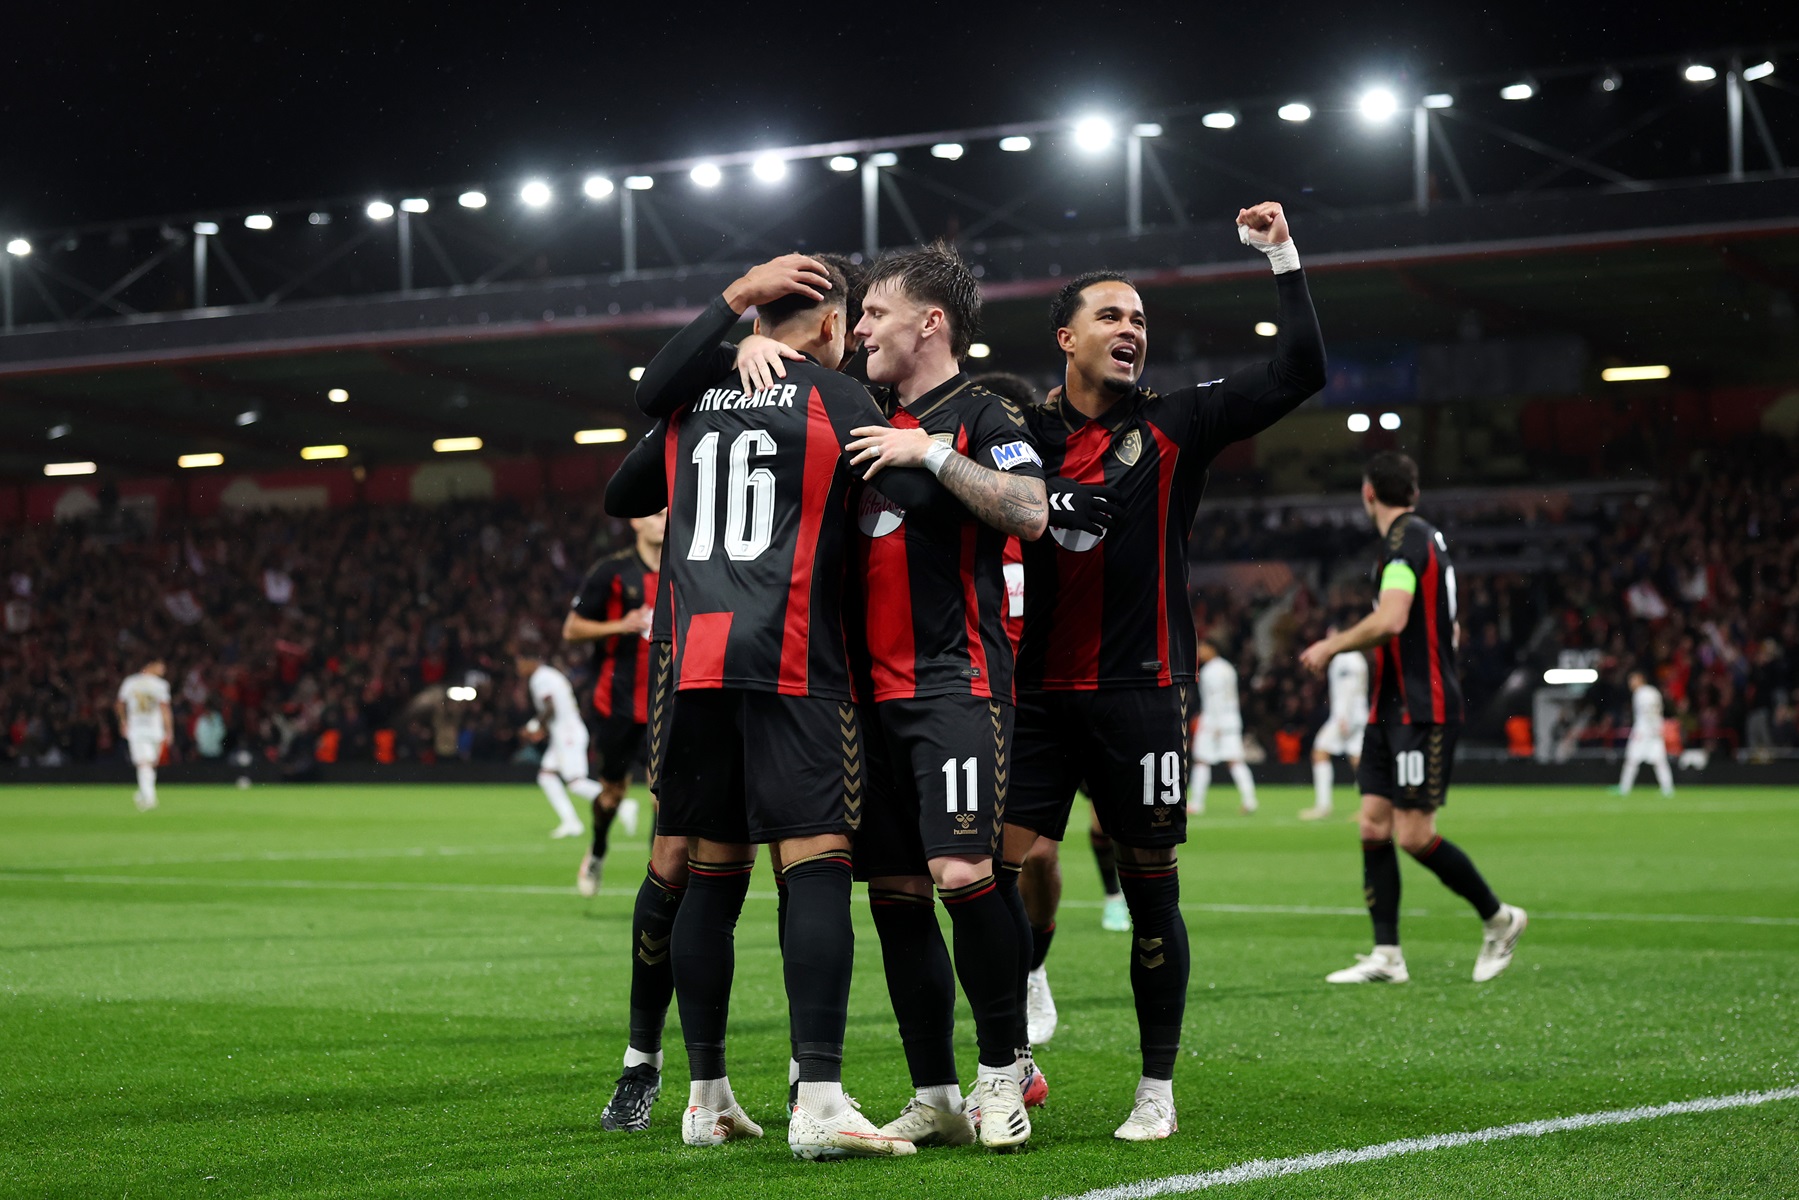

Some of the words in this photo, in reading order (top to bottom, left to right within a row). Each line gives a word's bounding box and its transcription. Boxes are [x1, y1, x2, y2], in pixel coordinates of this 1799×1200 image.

[692, 384, 798, 412] AVERNIER
[687, 429, 777, 561] 16
[941, 757, 978, 813] 11
[1140, 751, 1181, 805] 19
[1396, 750, 1424, 786] 10
